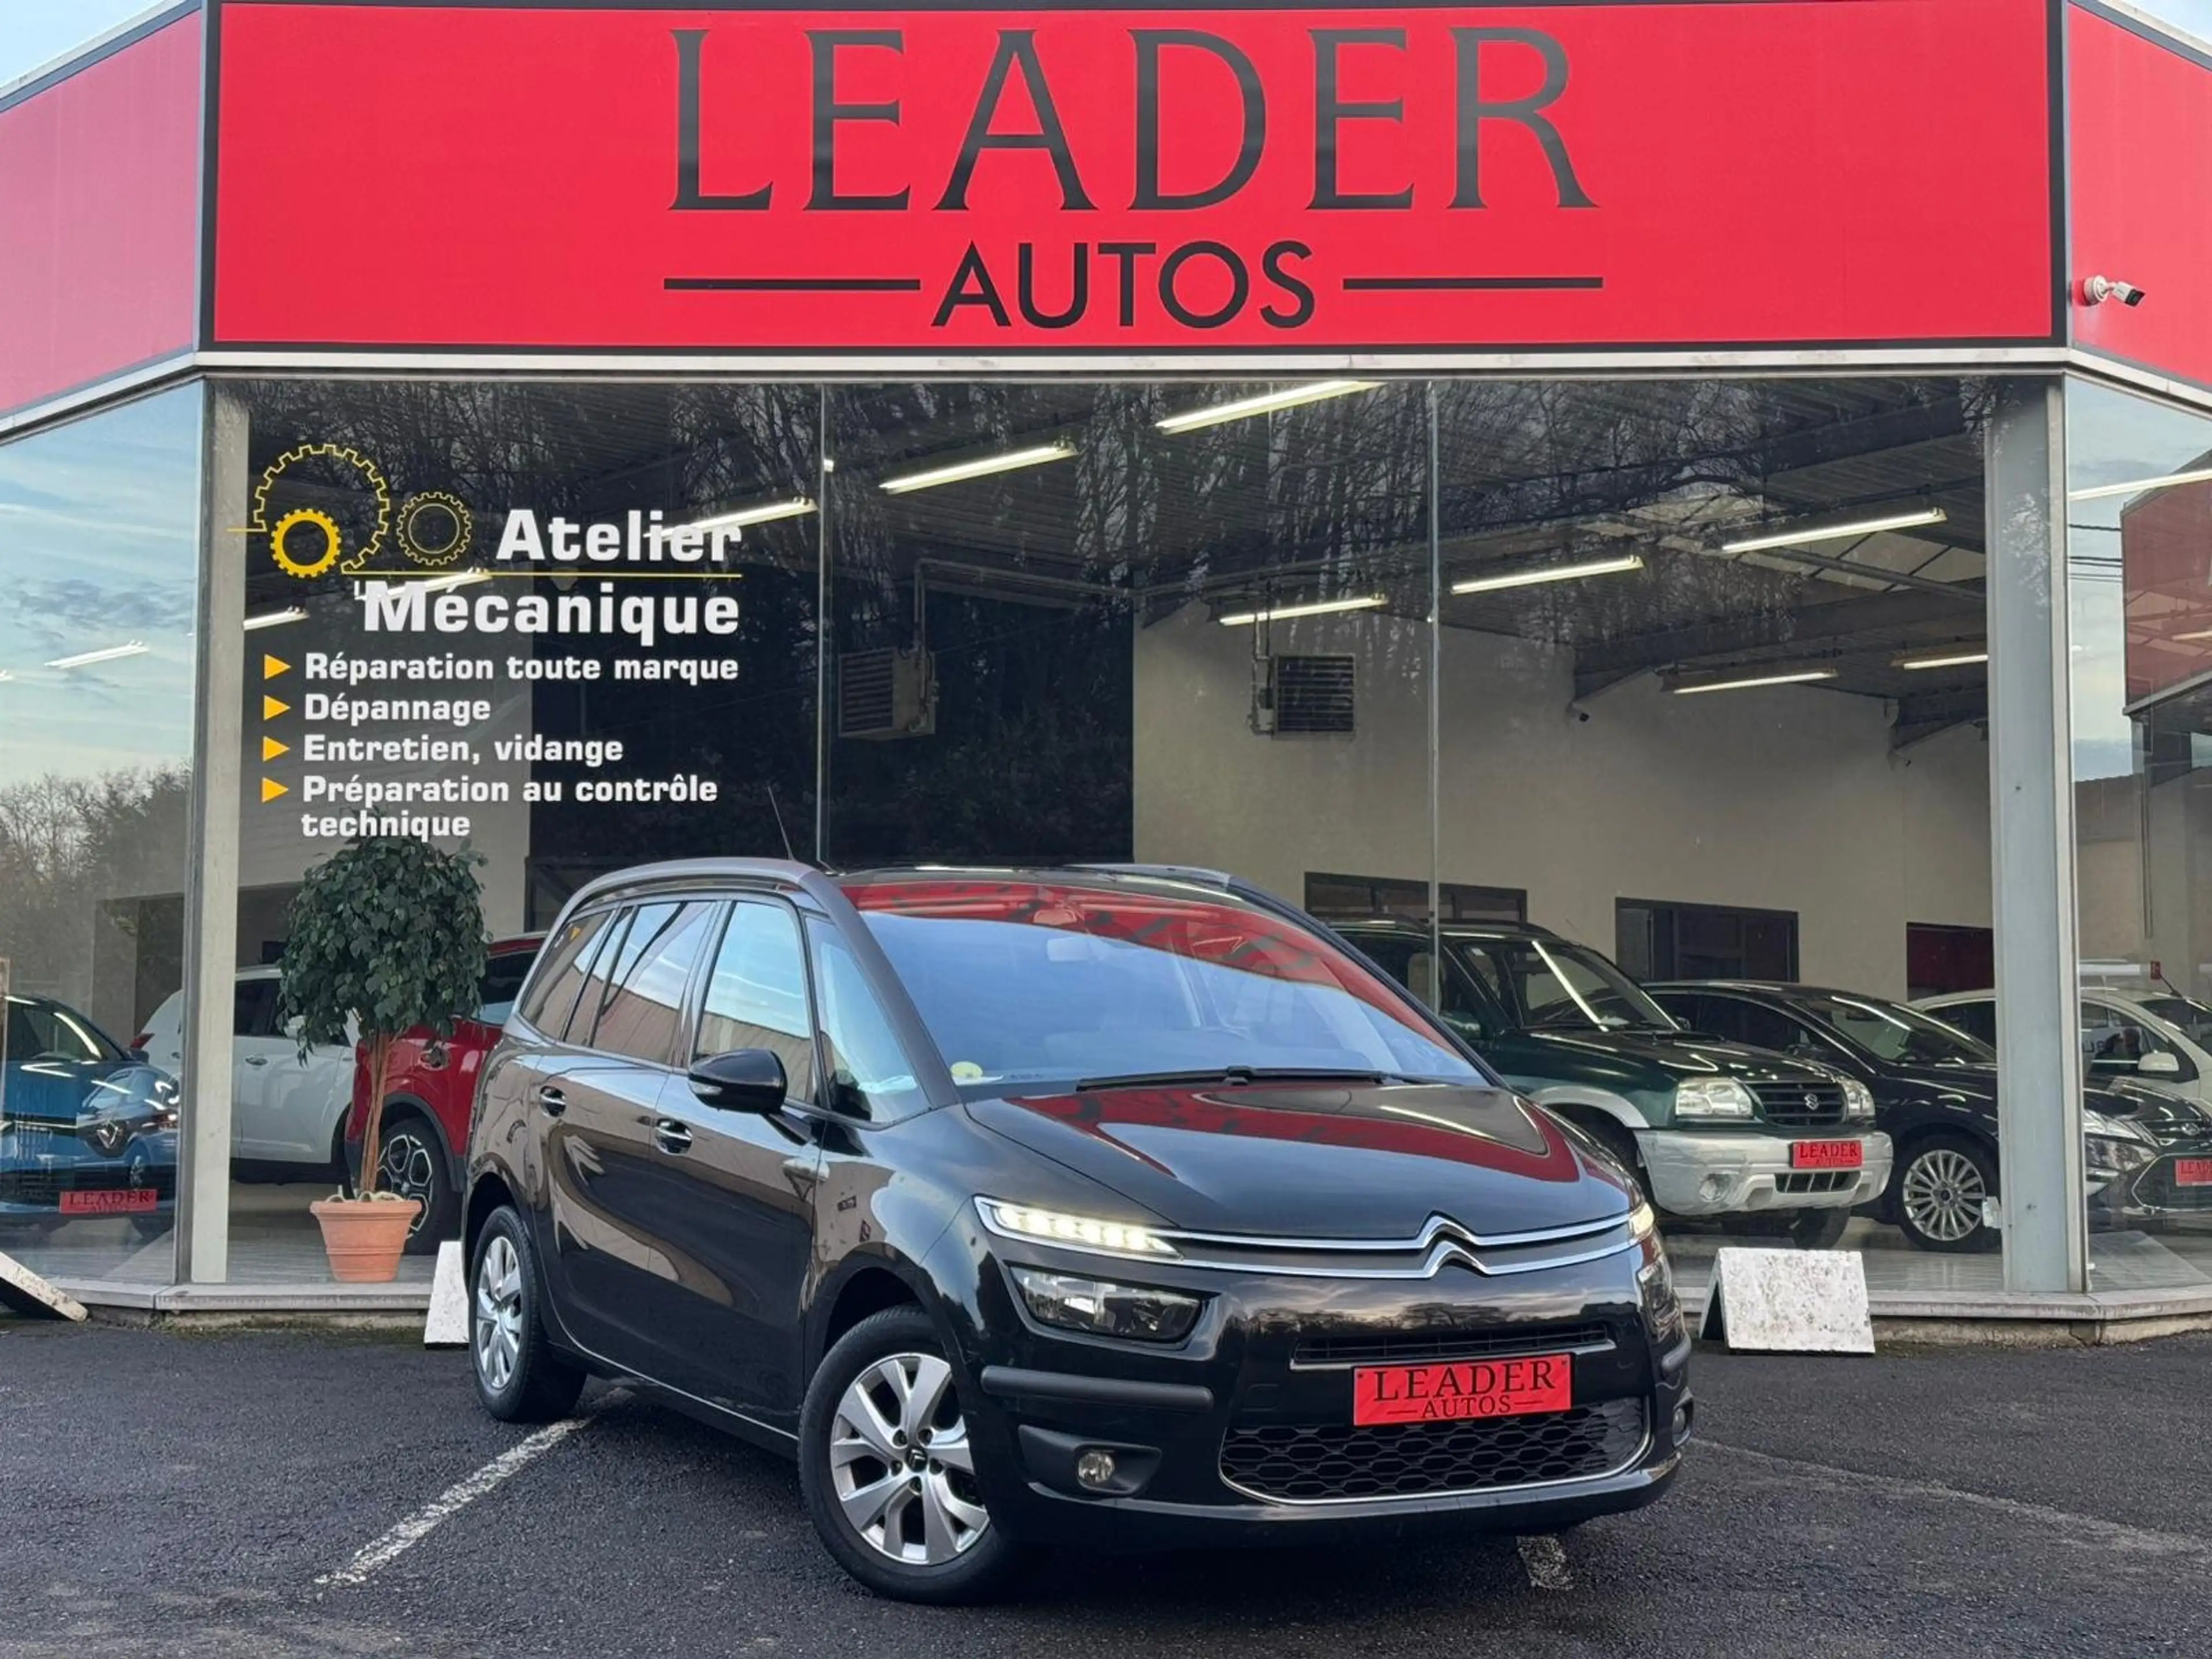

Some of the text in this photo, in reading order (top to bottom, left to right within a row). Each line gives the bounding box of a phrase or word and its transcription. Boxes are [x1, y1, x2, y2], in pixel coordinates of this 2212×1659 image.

[669, 28, 1601, 211] LEADER
[931, 240, 1316, 330] AUTOS
[495, 509, 743, 562] Atelier
[363, 581, 739, 646] Mécanique
[305, 652, 738, 685] Réparation toute marque
[304, 694, 491, 727] Dépannage
[303, 733, 624, 767] Entretien, vidange
[302, 774, 718, 809] Préparation au contrôle
[301, 813, 471, 843] technique
[1800, 1142, 1858, 1158] LEADER
[69, 1191, 150, 1206] LEADER
[1373, 1359, 1556, 1402] LEADER
[1421, 1395, 1511, 1419] AUTOS
